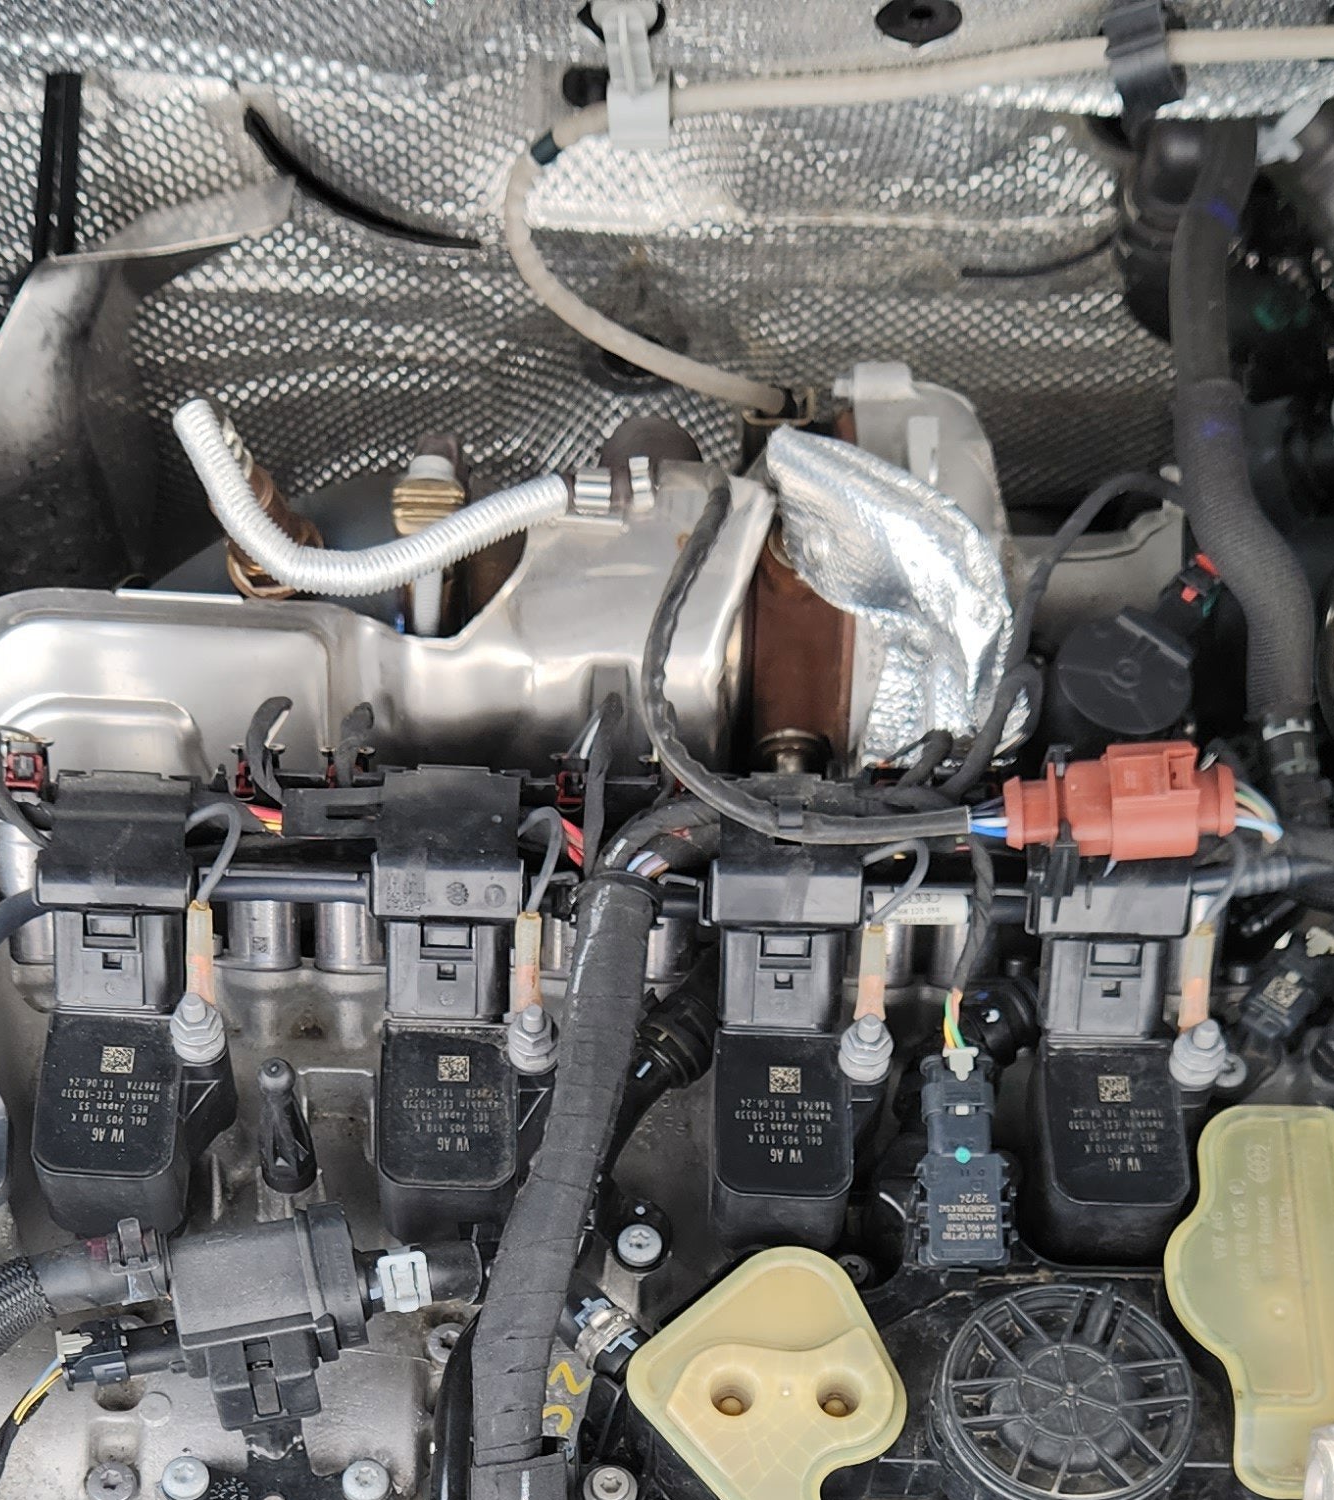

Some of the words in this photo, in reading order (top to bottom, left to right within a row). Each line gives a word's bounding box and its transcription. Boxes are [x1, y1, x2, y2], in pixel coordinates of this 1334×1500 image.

[96, 1101, 125, 1112] Japan
[70, 1112, 76, 1121] K
[105, 1113, 123, 1124] 905
[129, 1115, 147, 1126] 06L
[413, 1123, 420, 1132] K
[769, 1122, 798, 1132] Japan
[90, 1127, 106, 1142] AG
[110, 1127, 124, 1143] VW
[747, 1134, 753, 1143] K
[758, 1134, 775, 1144] 110
[436, 1136, 451, 1151] AG
[456, 1136, 469, 1151] VW
[769, 1148, 784, 1162] AG
[788, 1148, 803, 1163] VW
[1107, 1157, 1120, 1171] AG
[1126, 1156, 1140, 1171] VW
[958, 1193, 987, 1203] 28/24
